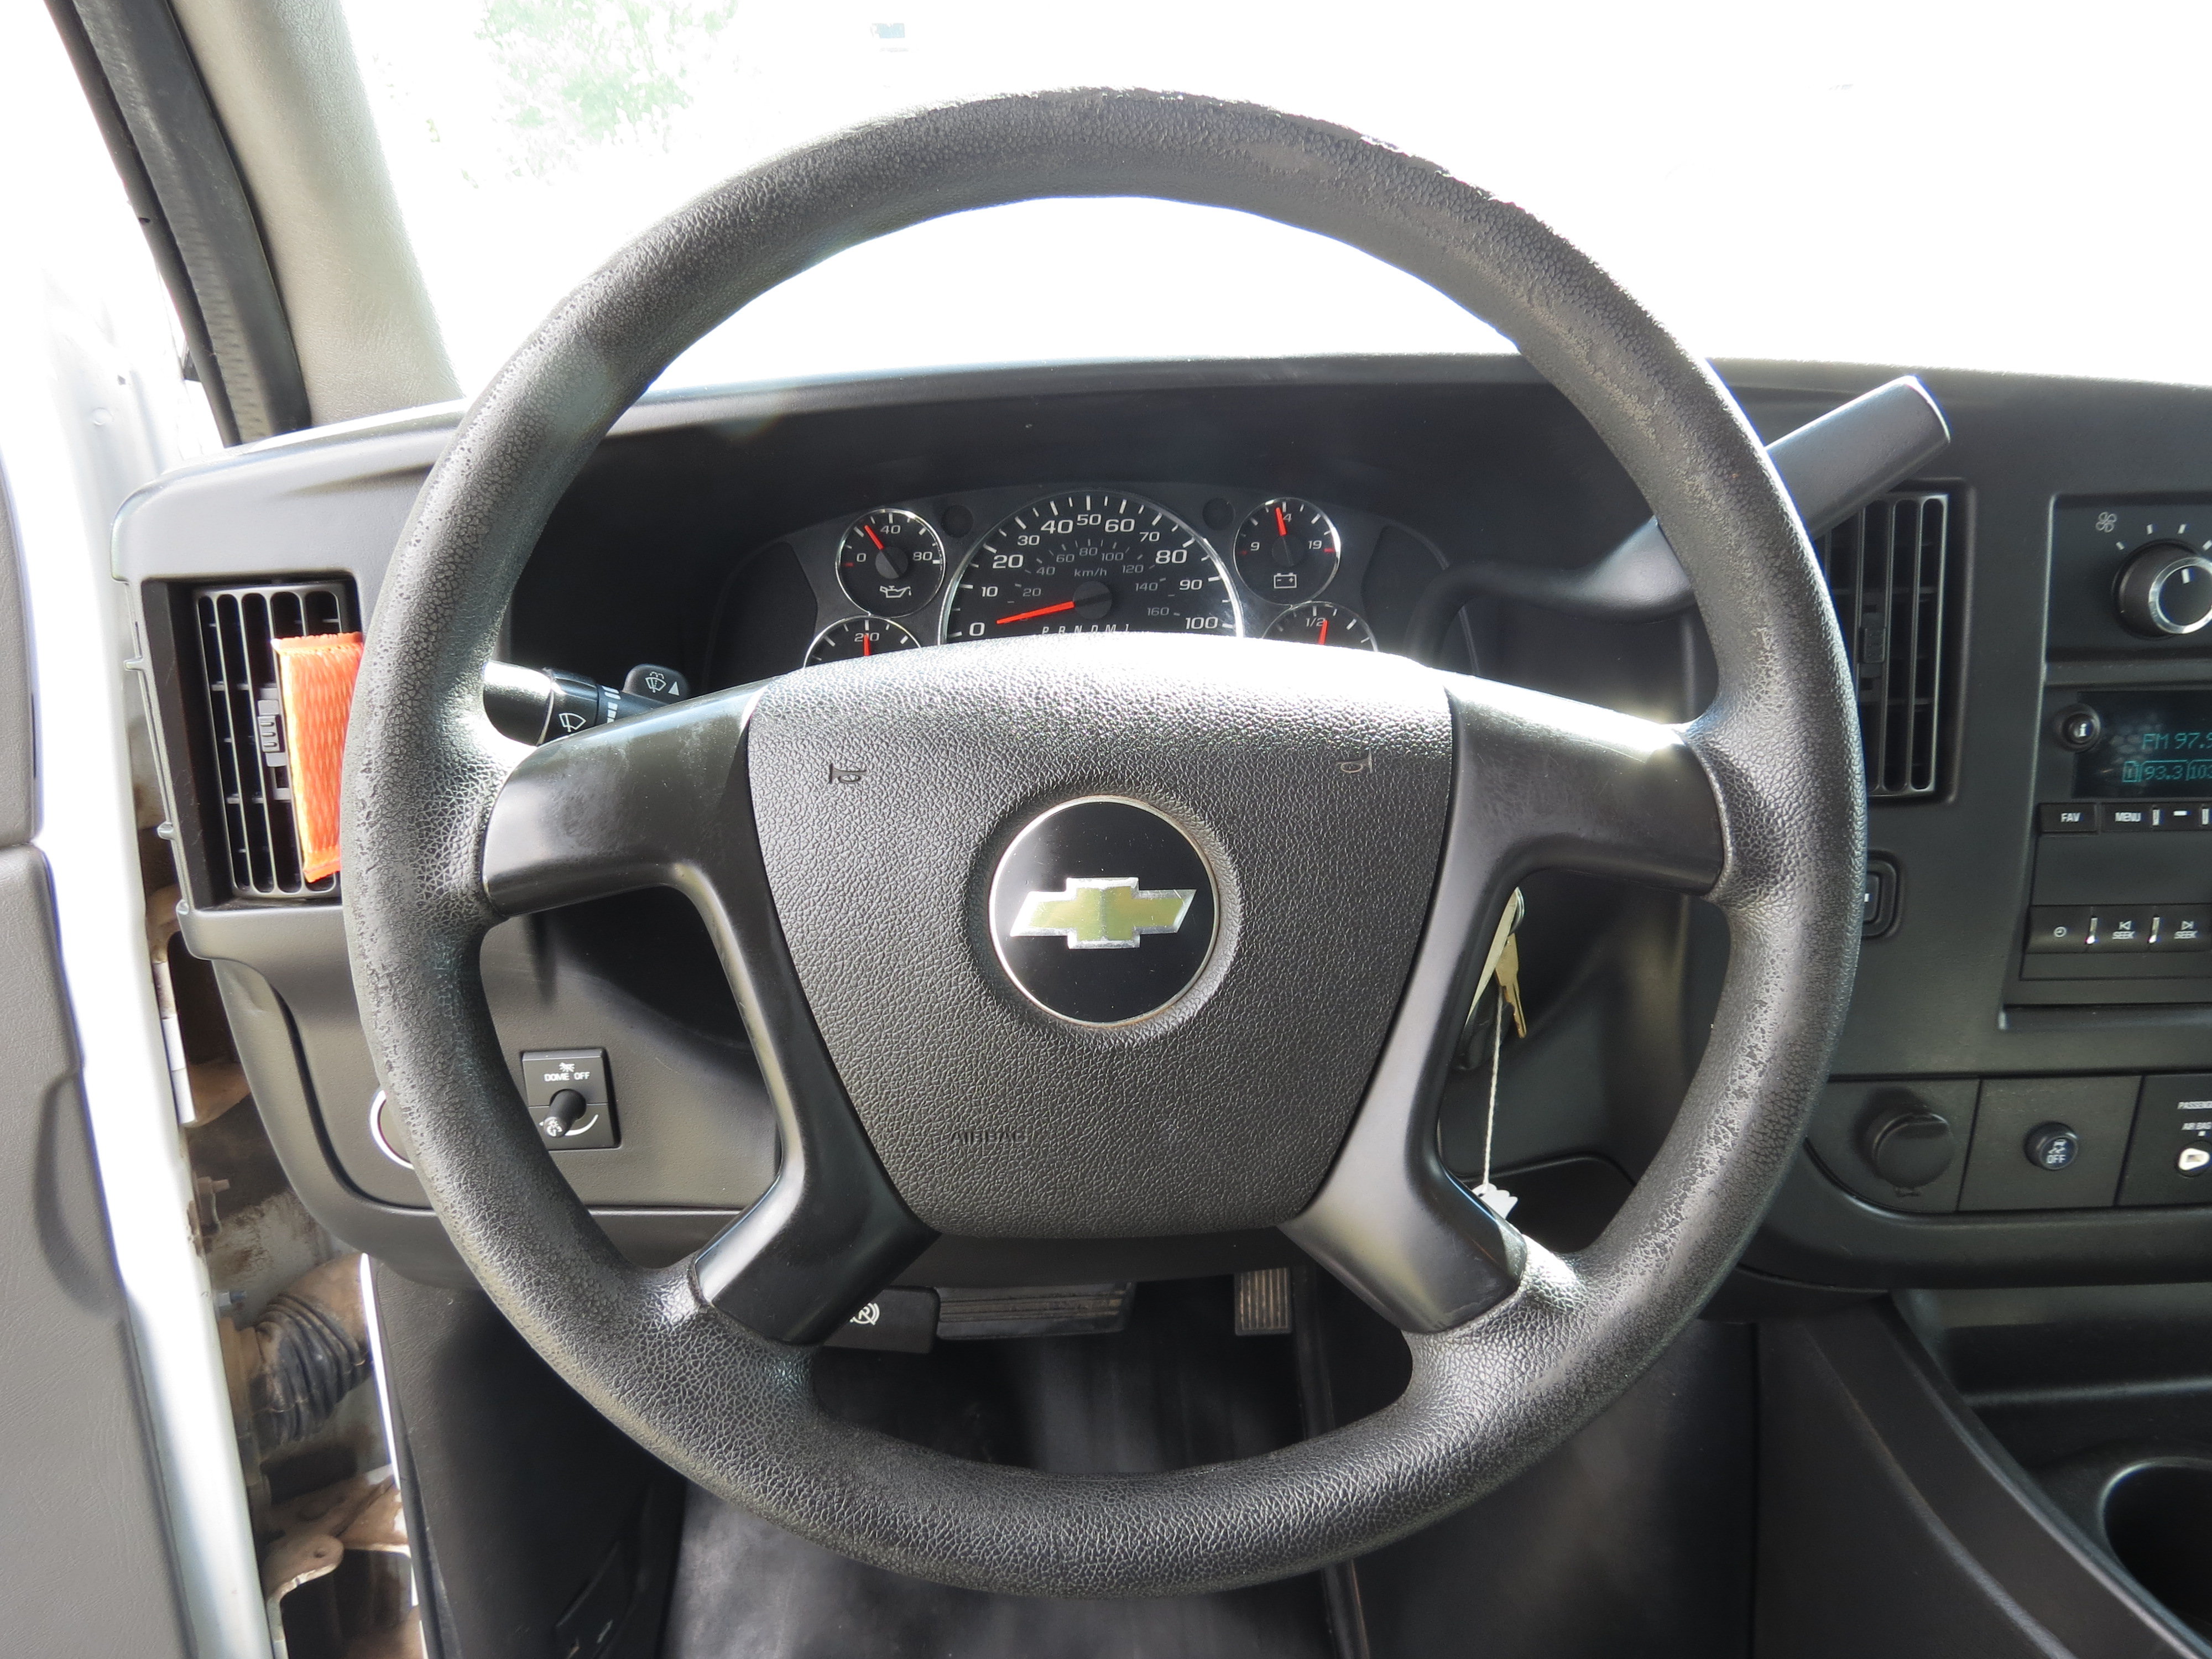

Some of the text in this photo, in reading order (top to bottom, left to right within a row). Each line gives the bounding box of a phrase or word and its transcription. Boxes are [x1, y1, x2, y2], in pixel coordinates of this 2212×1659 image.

[1077, 514, 1102, 526] 50
[880, 525, 901, 535] 40
[1041, 520, 1073, 534] 40
[1105, 519, 1135, 533] 60
[1018, 535, 1040, 546] 30
[1139, 531, 1160, 542] 70
[1250, 542, 1260, 551] 9
[1308, 540, 1322, 550] 19
[856, 552, 867, 562] 0
[913, 551, 933, 561] 80
[1079, 547, 1098, 557] 80
[1102, 552, 1124, 561] 100
[992, 554, 1024, 569] 20
[1056, 554, 1074, 563] 60
[1155, 550, 1187, 565] 80
[1036, 567, 1056, 576] 40
[1074, 567, 1107, 577] km/h
[1121, 565, 1144, 574] 120
[1135, 582, 1158, 592] 140
[1179, 580, 1203, 591] 90
[981, 586, 999, 597] 10
[1022, 588, 1042, 597] 20
[1147, 607, 1170, 617] 160
[1185, 617, 1219, 630] 100
[1306, 617, 1326, 628] 1/2
[969, 622, 985, 637] 0
[2142, 733, 2169, 750] FM
[2145, 765, 2183, 780] 93.3
[2061, 812, 2141, 822] FAV MENU
[2112, 931, 2135, 940] SEEK
[2174, 931, 2198, 940] SEEK
[544, 1072, 590, 1082] DOME OFF
[2046, 1154, 2066, 1164] OFF
